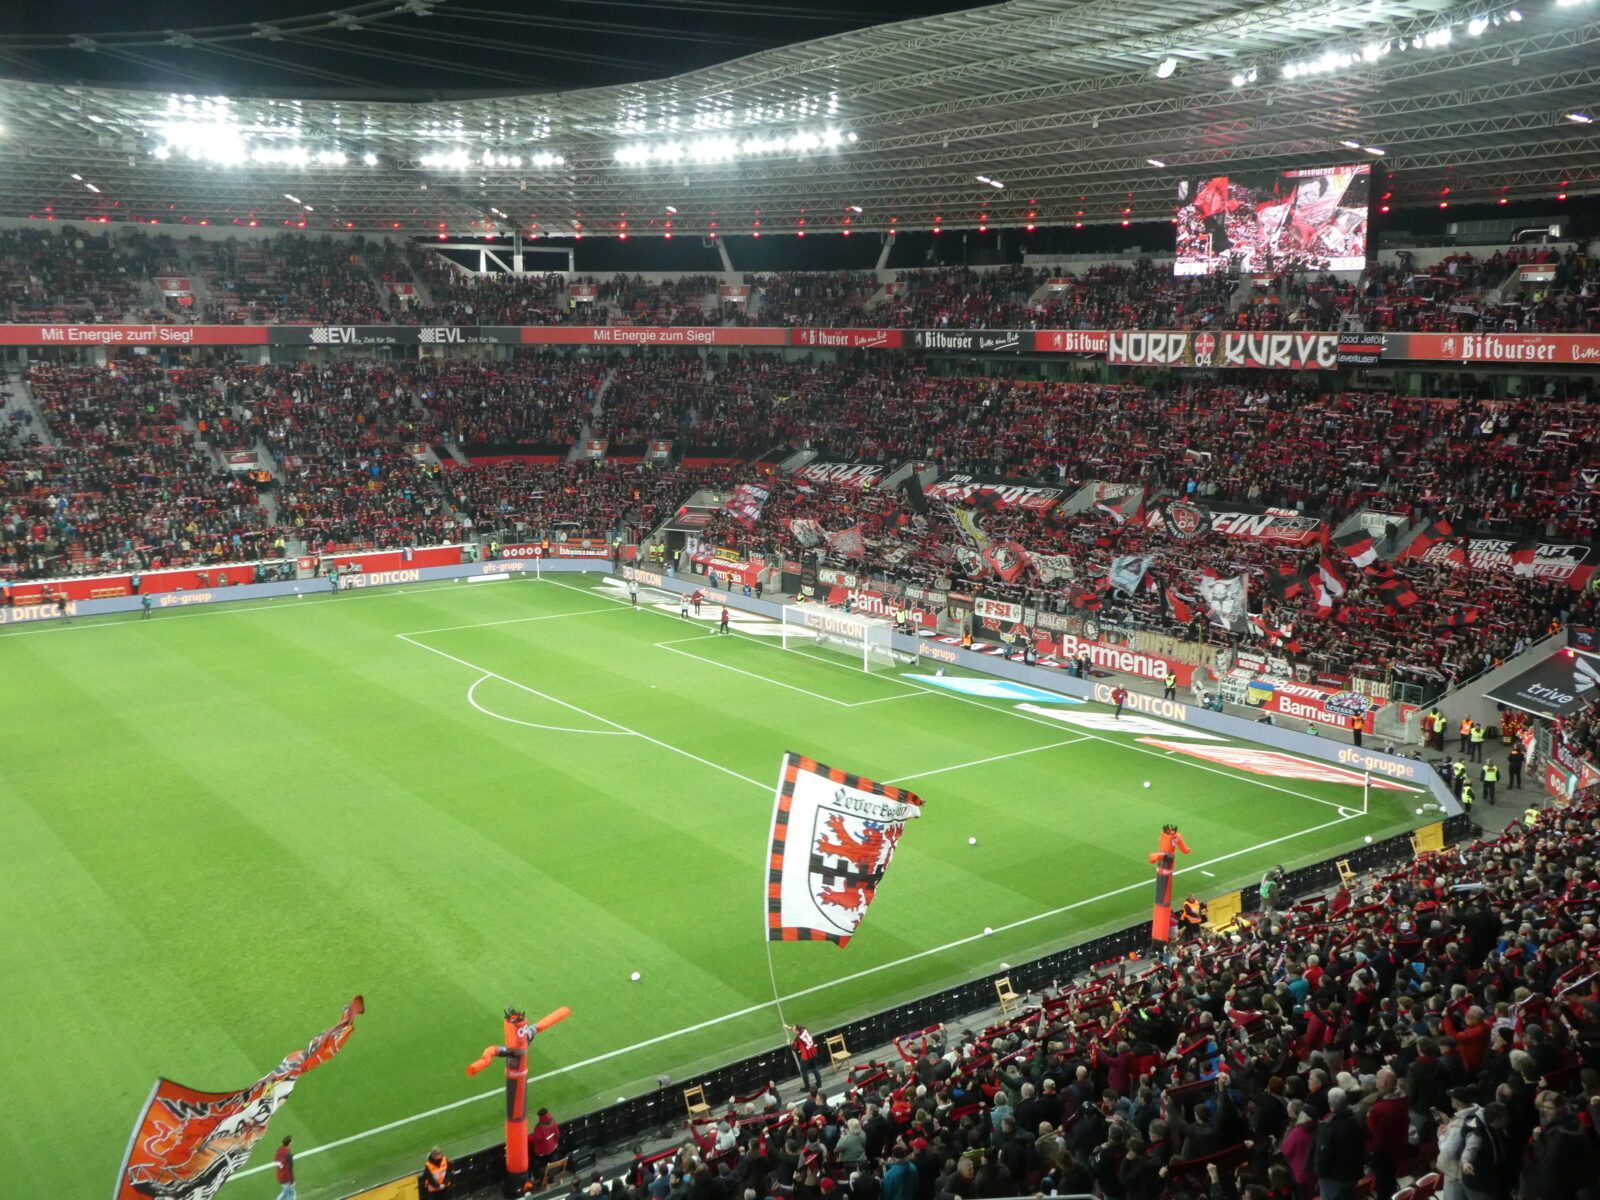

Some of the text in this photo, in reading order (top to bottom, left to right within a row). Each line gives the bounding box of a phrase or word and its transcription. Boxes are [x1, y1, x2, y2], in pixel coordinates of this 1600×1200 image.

[41, 328, 193, 343] Mit Energie zum Sieg!
[328, 328, 357, 343] EVL
[435, 328, 465, 343] EVL
[594, 330, 715, 343] Mit Energie zum Sieg!
[809, 330, 849, 345] Bitburger
[925, 332, 973, 348] Bitburger
[1065, 333, 1107, 351] Bitbur
[1109, 333, 1187, 363] NORD
[1225, 334, 1338, 368] KURVE
[1461, 335, 1556, 360] Bitburger
[1195, 353, 1212, 367] 04
[370, 569, 419, 584] DITCON
[635, 569, 662, 587] DITCON
[825, 617, 863, 637] DITCON
[1063, 634, 1168, 680] Barmenia
[1527, 682, 1574, 704] trive
[1127, 692, 1187, 721] DITCON
[1338, 748, 1415, 777] gfc-gruppe
[832, 787, 908, 818] Leverk
